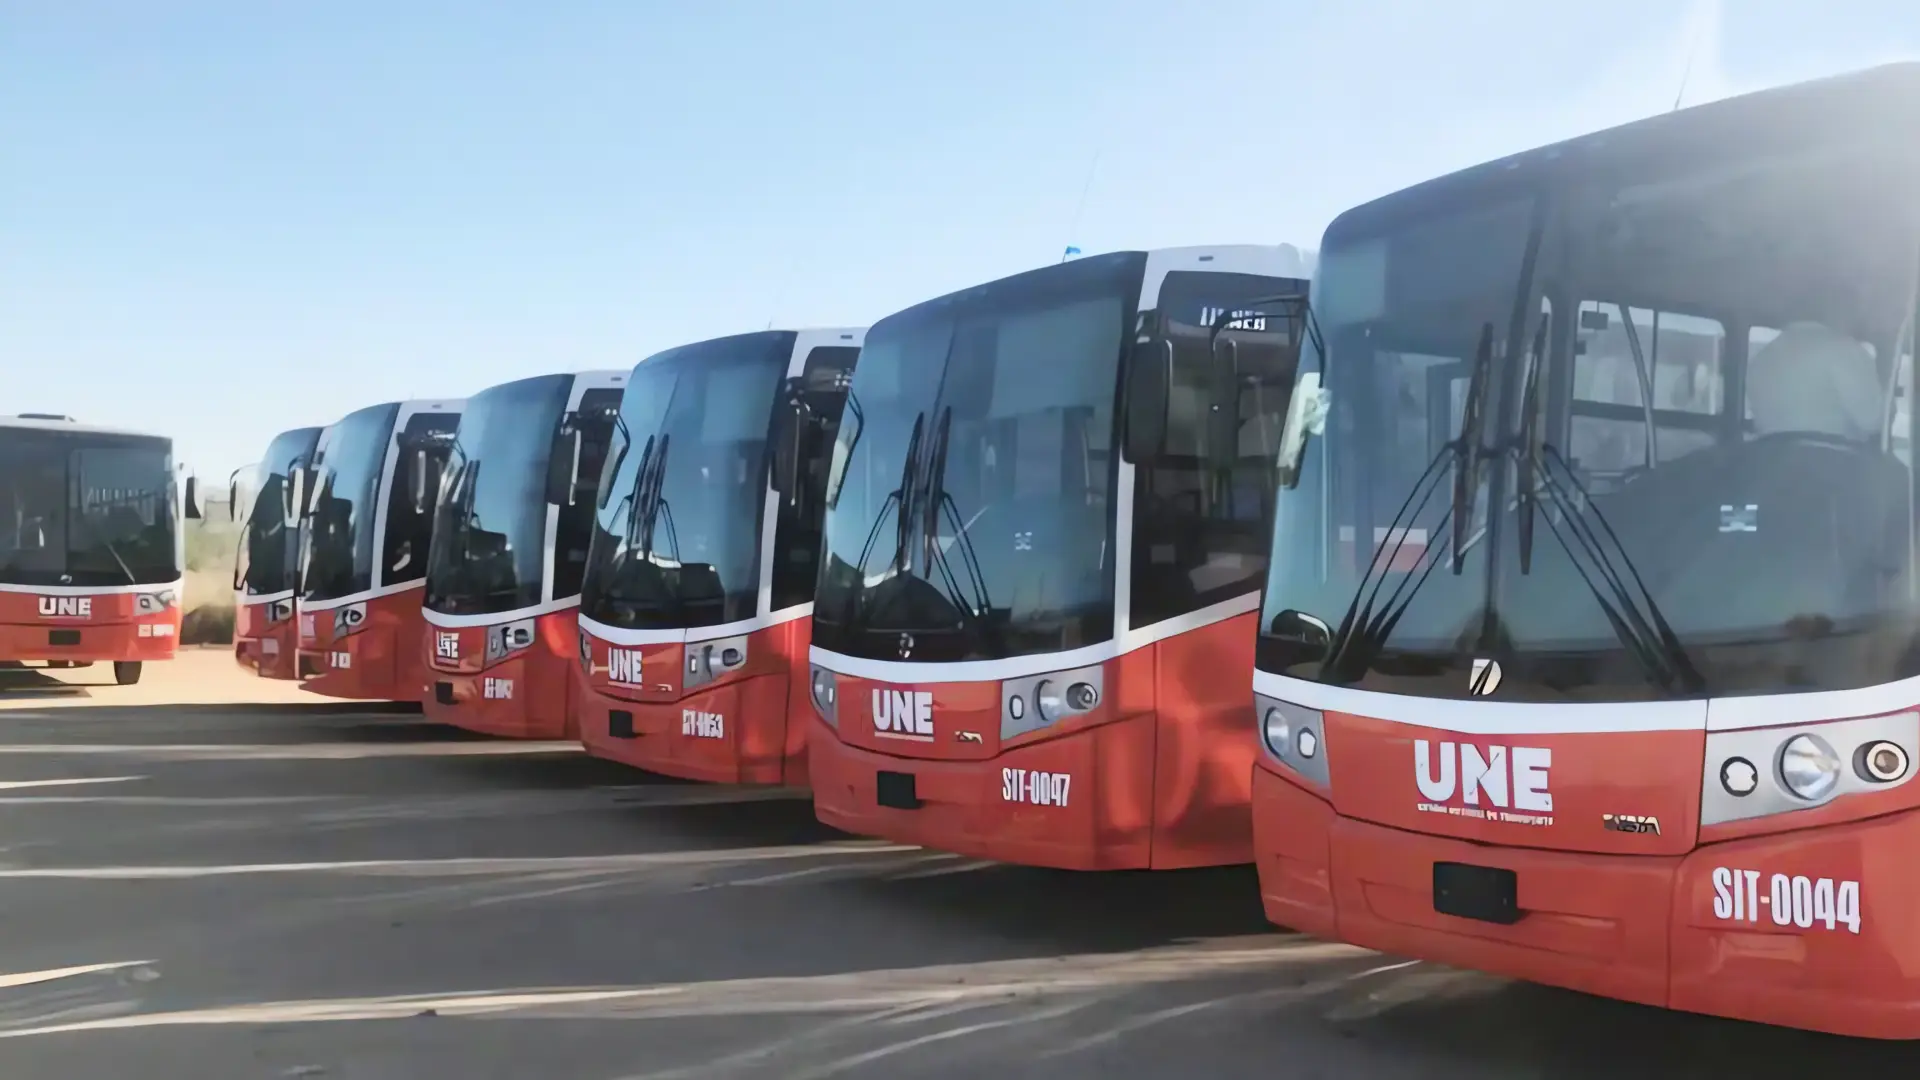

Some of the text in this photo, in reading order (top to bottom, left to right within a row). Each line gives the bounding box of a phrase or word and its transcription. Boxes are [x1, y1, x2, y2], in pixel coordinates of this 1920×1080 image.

[38, 597, 92, 616] UNE
[872, 688, 934, 733] UNE
[1002, 767, 1071, 807] SIT-0047
[1414, 739, 1553, 812] UNE
[1712, 866, 1861, 934] SIT-0044
